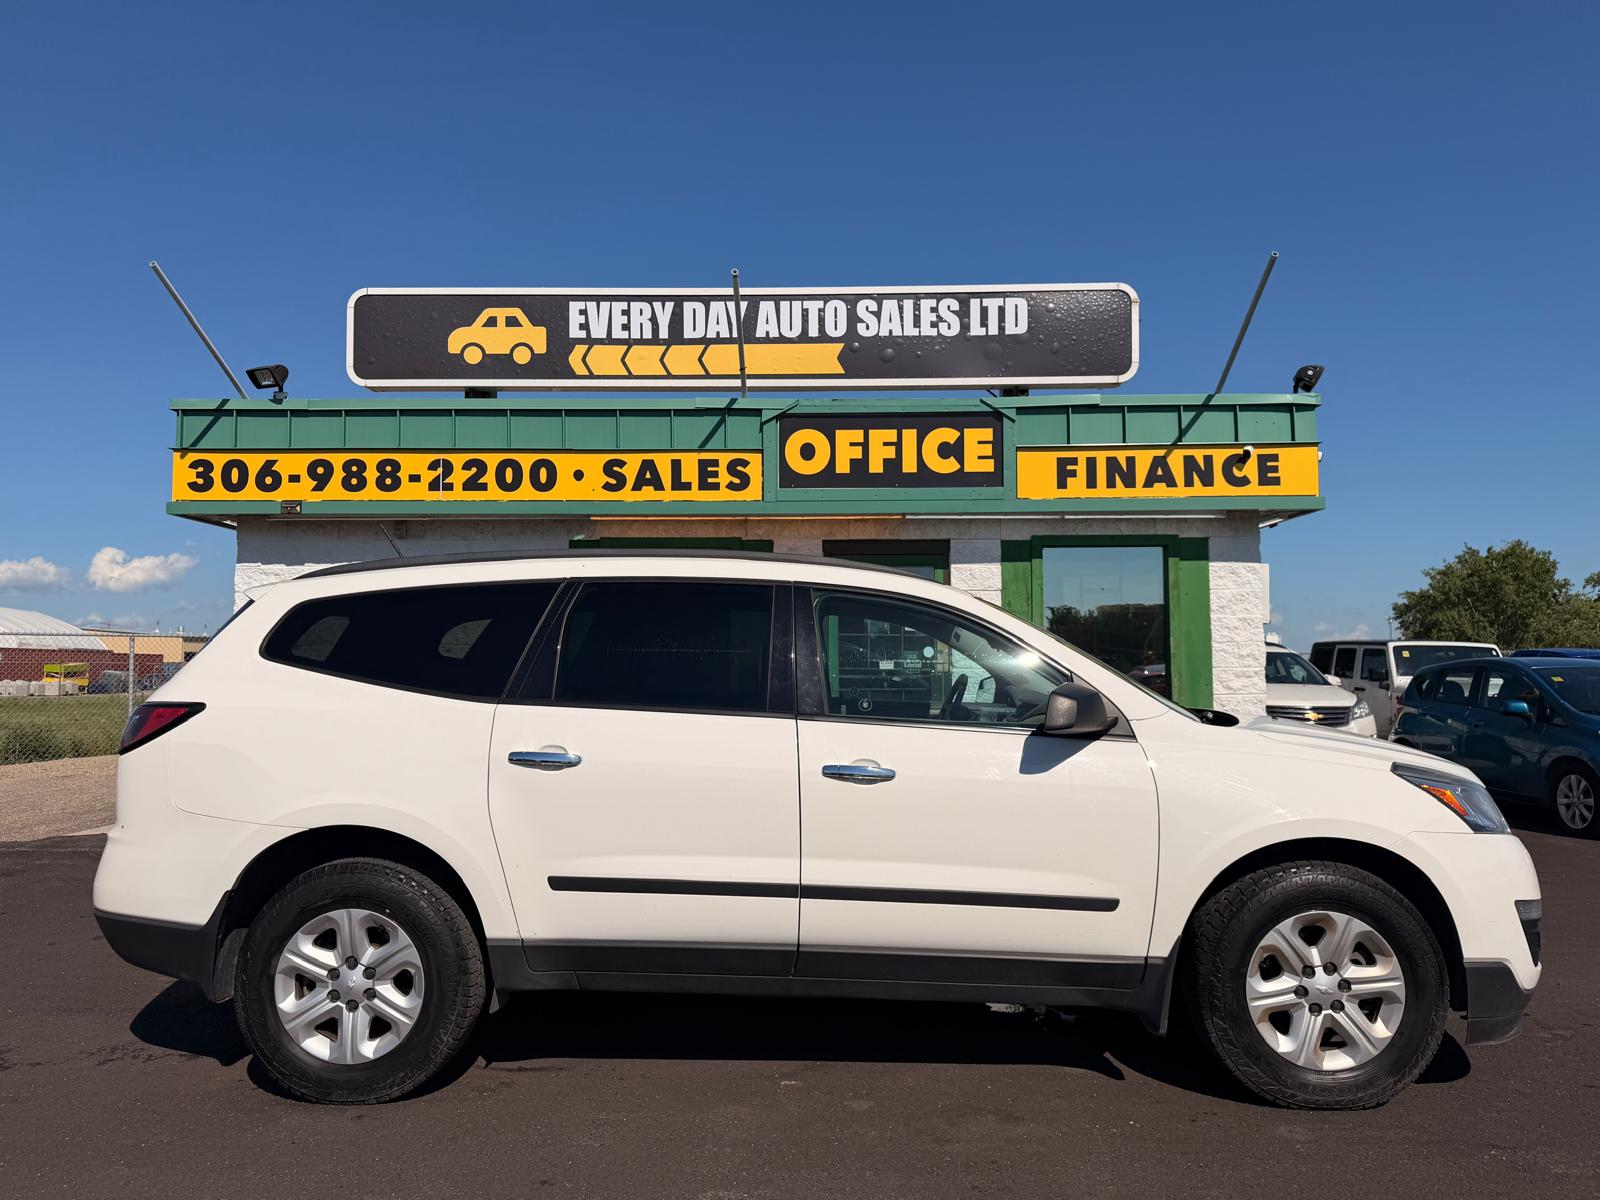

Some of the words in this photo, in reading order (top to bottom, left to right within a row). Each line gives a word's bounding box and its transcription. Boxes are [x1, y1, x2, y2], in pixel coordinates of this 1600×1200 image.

[569, 301, 674, 338] EVERY
[683, 301, 748, 338] DAY
[756, 300, 847, 338] AUTO
[857, 298, 960, 337] SALES
[968, 298, 1028, 336] LTD
[785, 428, 994, 475] OFFICE
[187, 459, 557, 492] 306-988-2200
[602, 458, 750, 492] SALES
[1057, 454, 1280, 489] FINANCE
